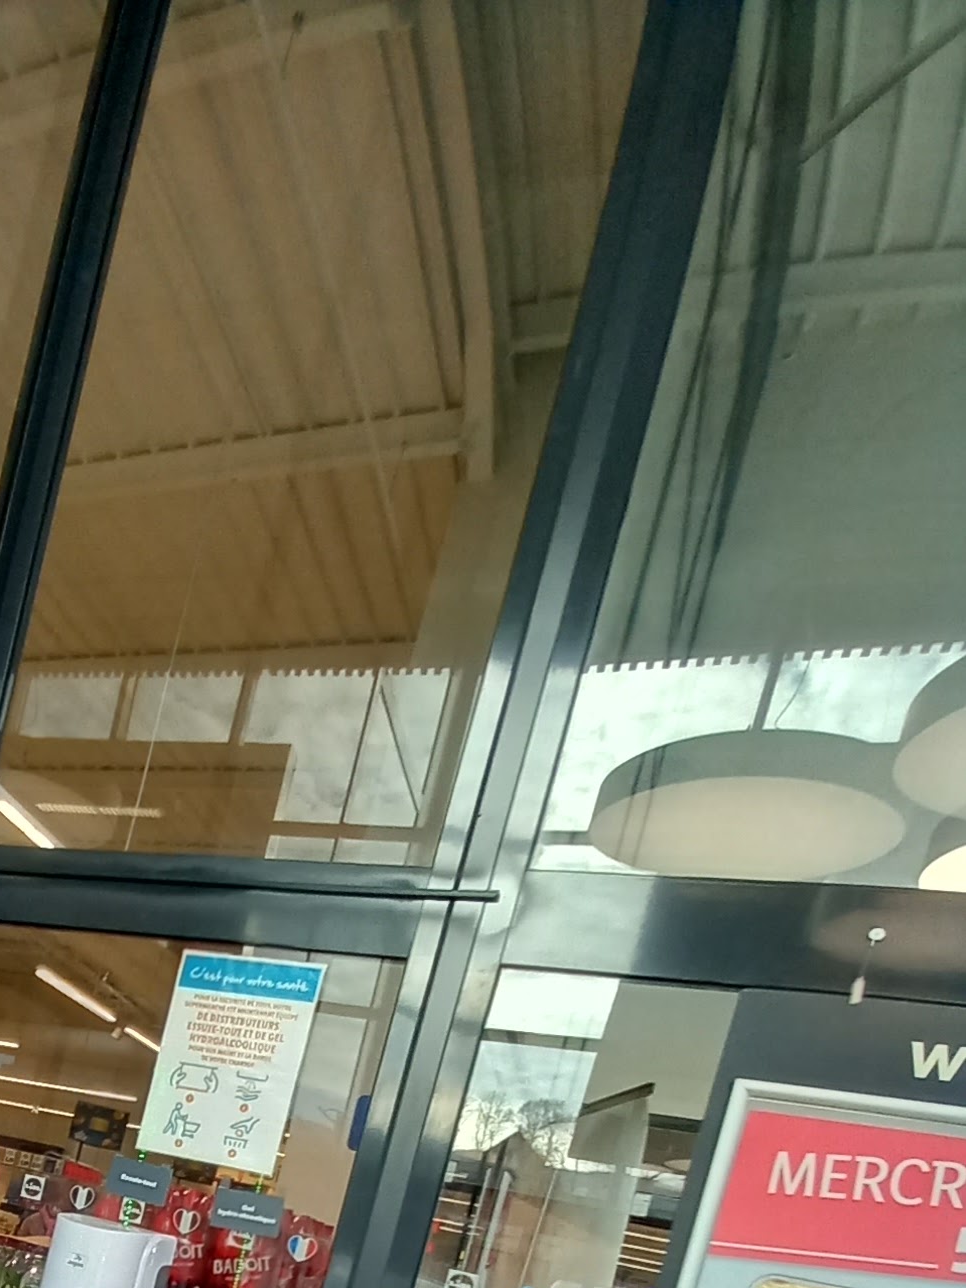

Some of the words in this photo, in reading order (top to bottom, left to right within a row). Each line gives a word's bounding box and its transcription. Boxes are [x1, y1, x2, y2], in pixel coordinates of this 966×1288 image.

[189, 966, 221, 980] C'est
[196, 1011, 208, 1021] DE
[210, 1013, 280, 1031] DISTRIBUTEURS
[243, 1029, 253, 1039] ET
[255, 1030, 267, 1040] DE
[268, 1032, 284, 1043] GEL
[767, 1151, 966, 1209] MERCR
[212, 1257, 271, 1276] BADOIT
